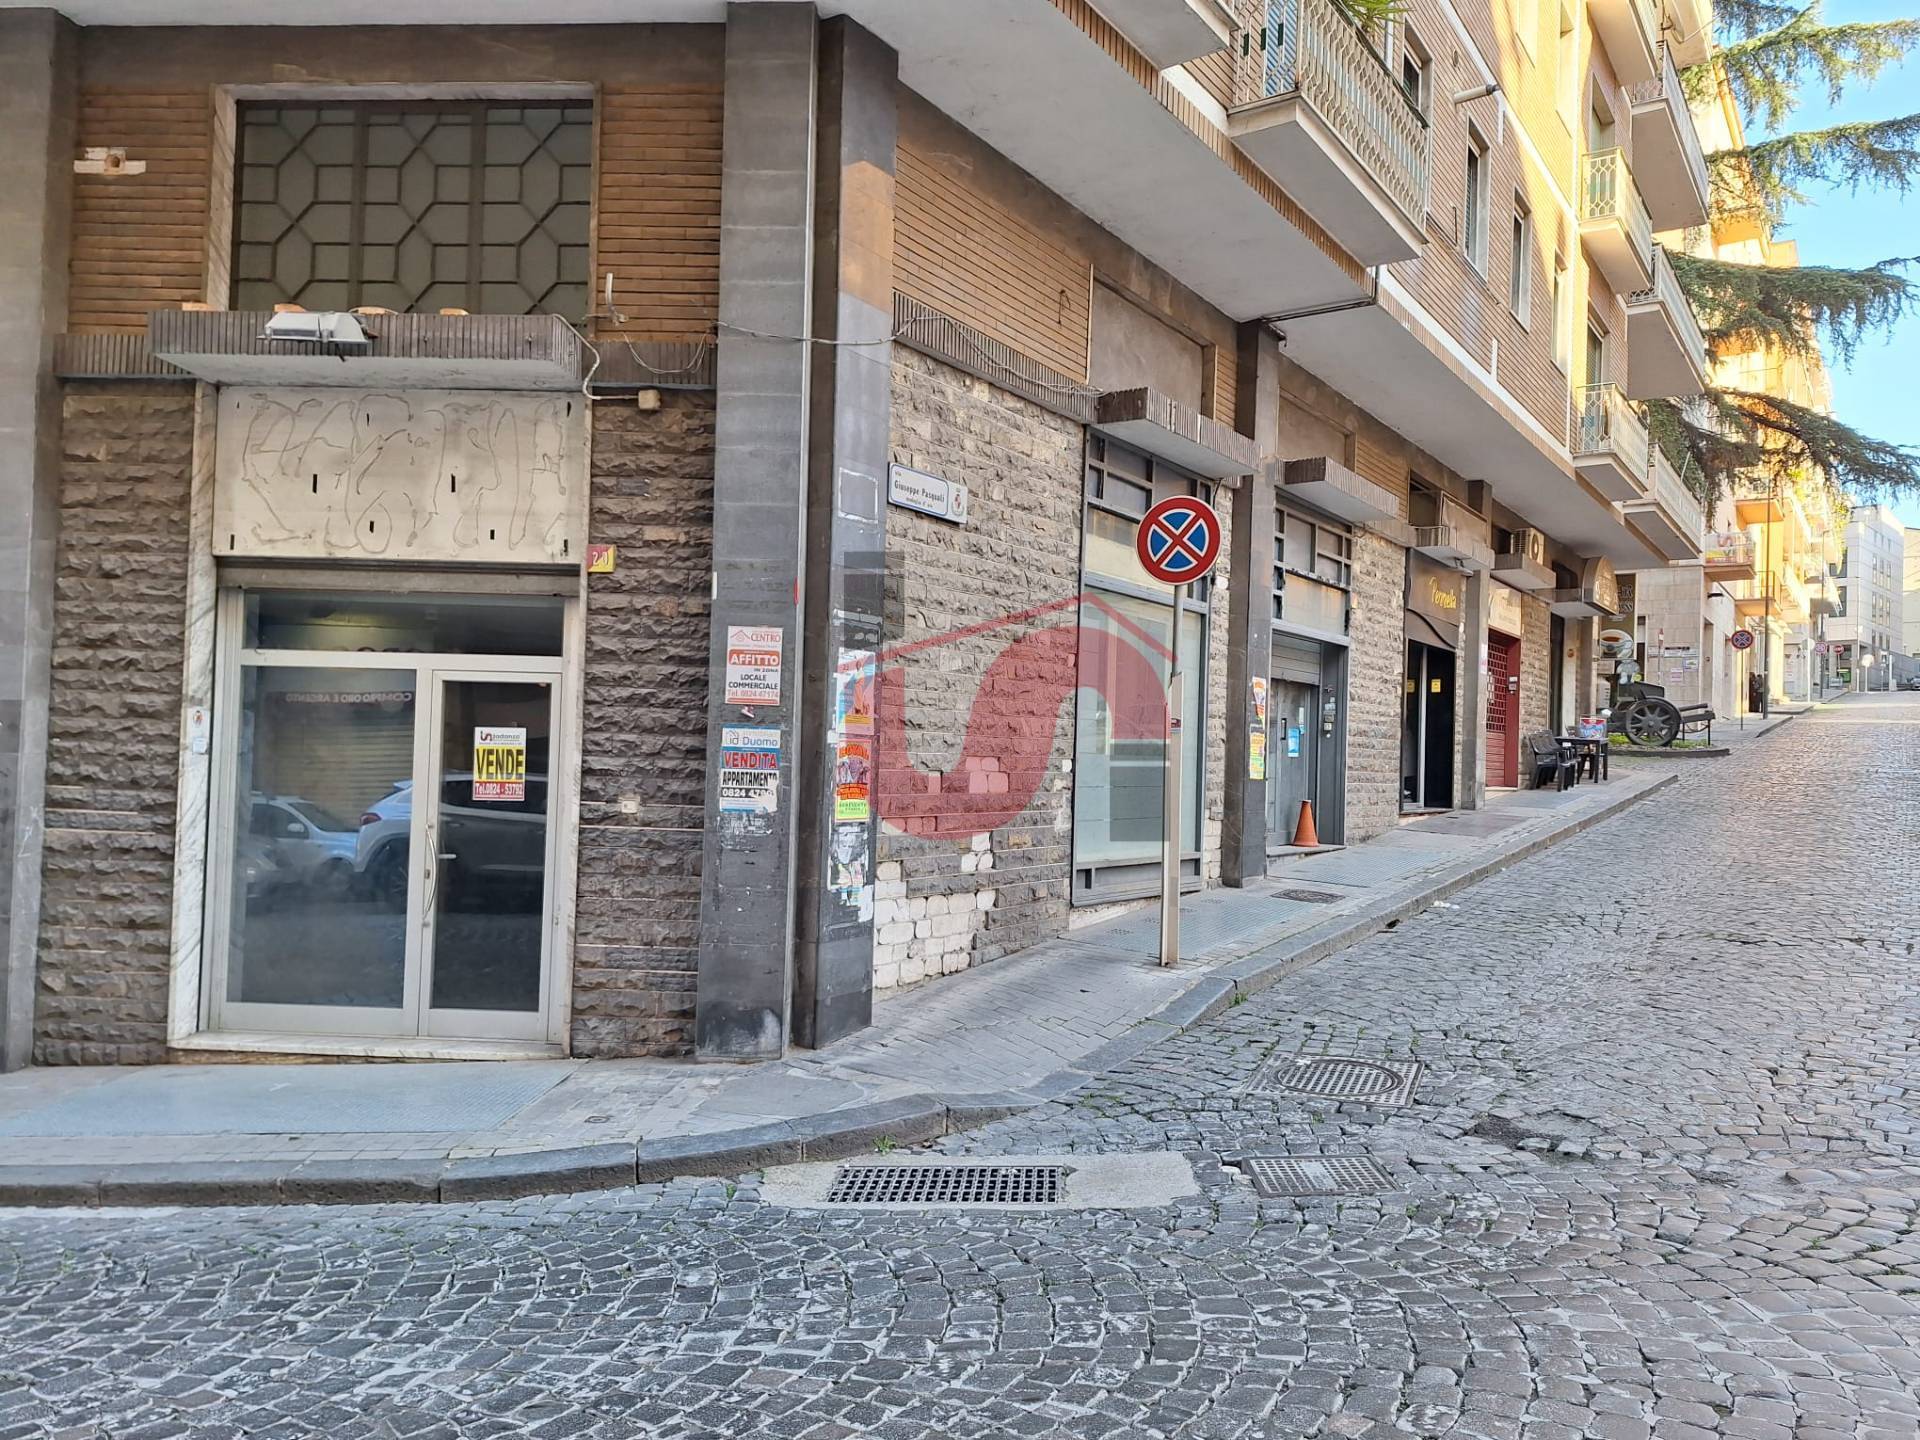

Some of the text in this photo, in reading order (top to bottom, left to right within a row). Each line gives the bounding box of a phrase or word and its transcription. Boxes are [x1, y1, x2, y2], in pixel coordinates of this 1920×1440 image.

[894, 480, 920, 495] Giuseppe
[922, 488, 945, 503] Pasquali
[751, 633, 781, 642] CENTRO
[730, 654, 778, 665] AFFITTO
[728, 682, 778, 690] COMMERCIALE
[743, 737, 778, 746] Duomo
[476, 748, 523, 780] VENDE
[724, 751, 778, 769] VENDITA
